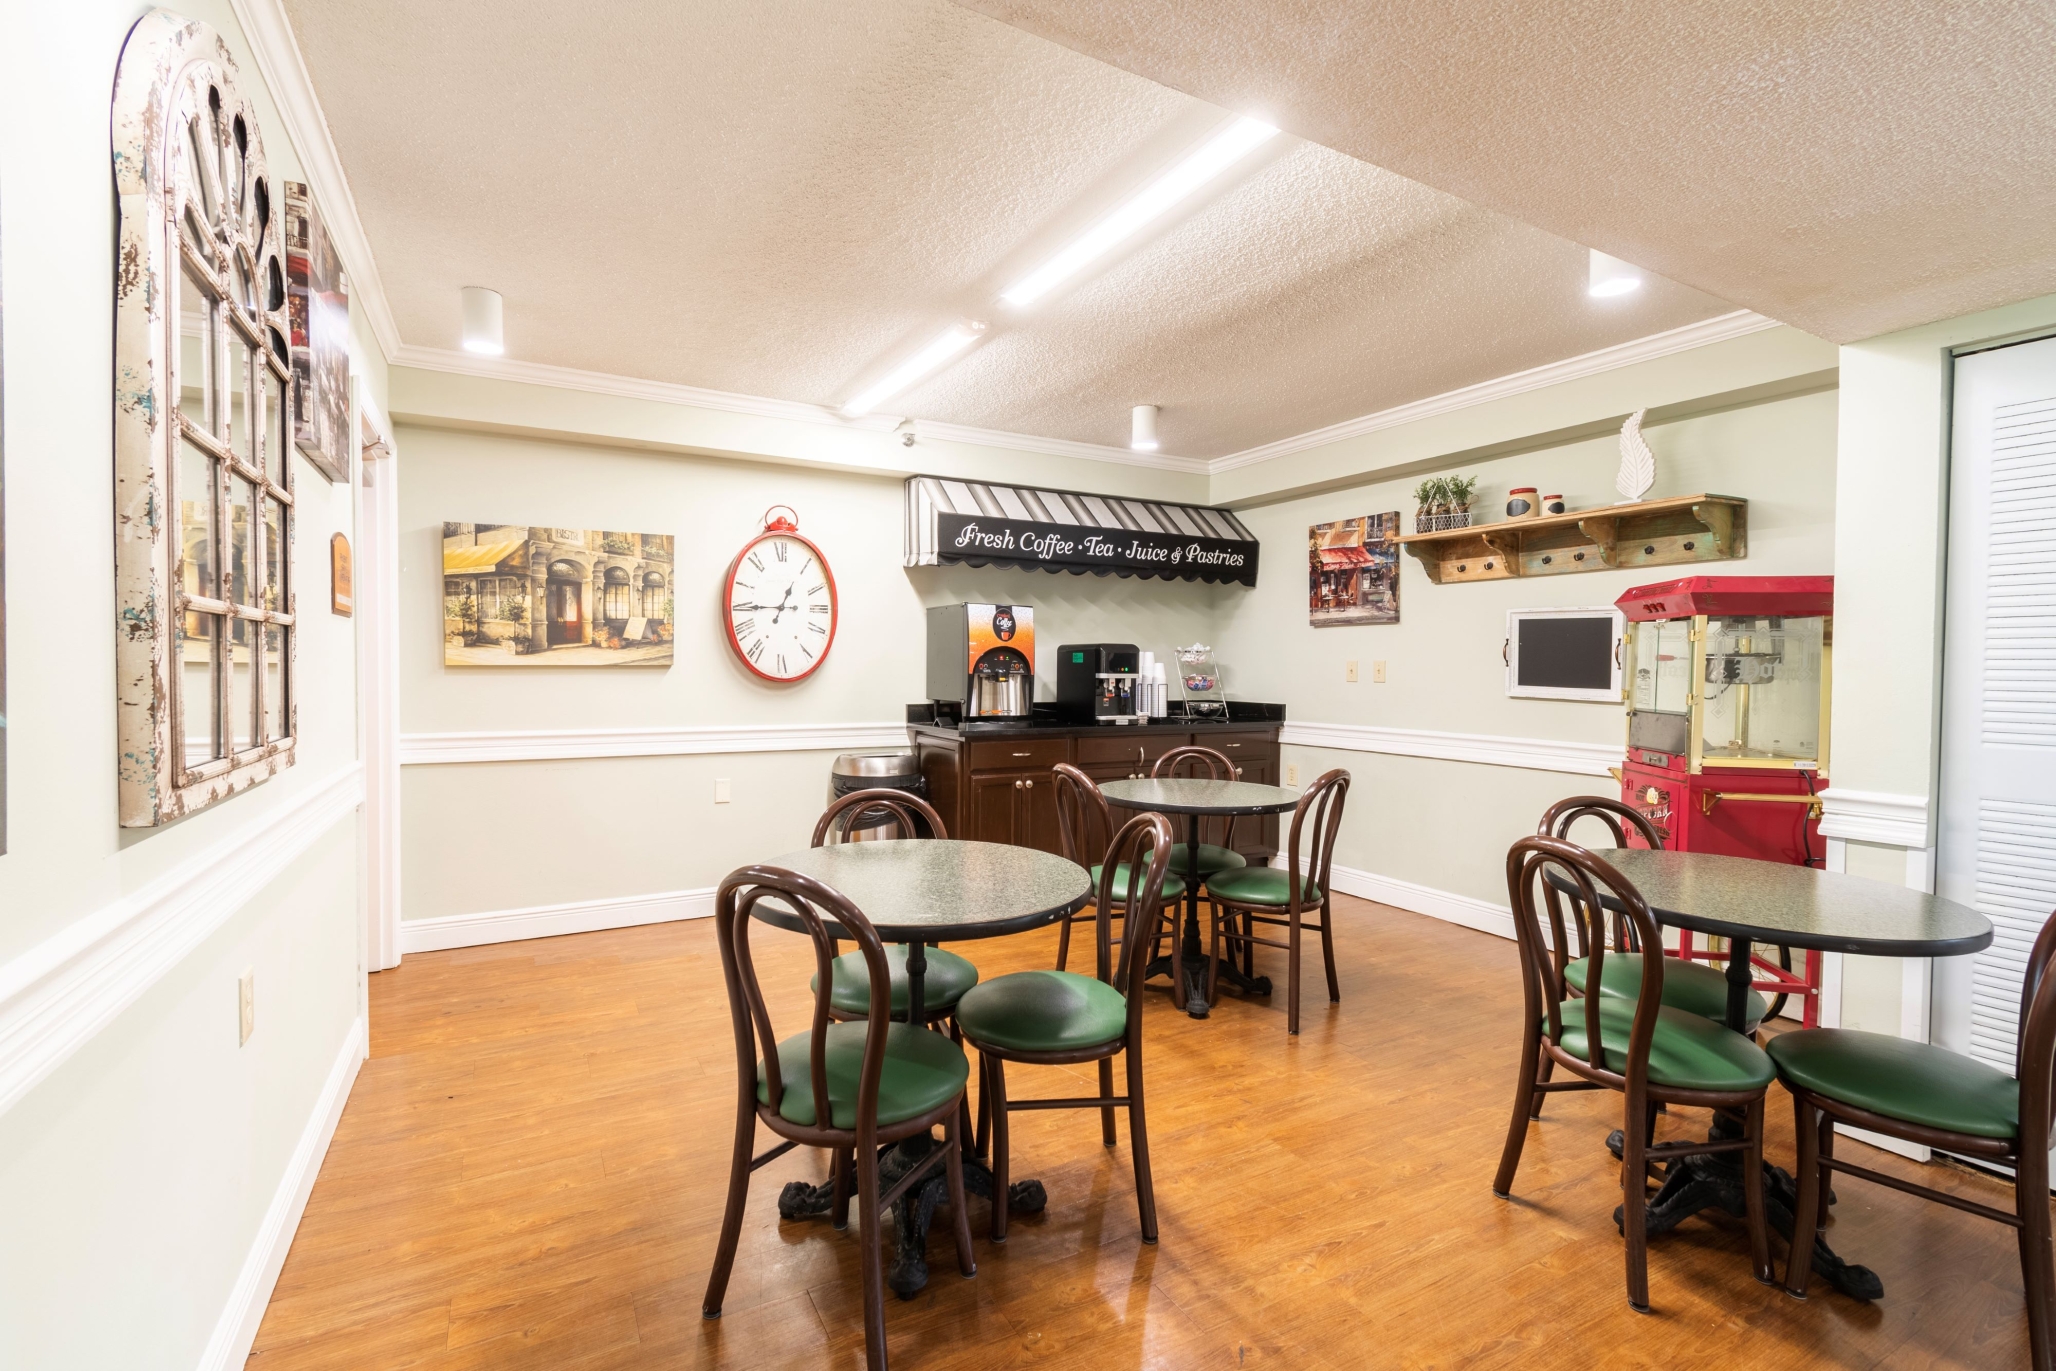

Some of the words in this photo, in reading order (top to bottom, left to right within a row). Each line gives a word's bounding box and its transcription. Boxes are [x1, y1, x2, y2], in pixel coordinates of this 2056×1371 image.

[955, 522, 1015, 549] Fresh
[1020, 532, 1074, 559] Coffee
[1084, 536, 1114, 557] Tea
[1126, 541, 1168, 561] Juice
[1171, 547, 1183, 564] &
[1186, 543, 1245, 566] Pastries
